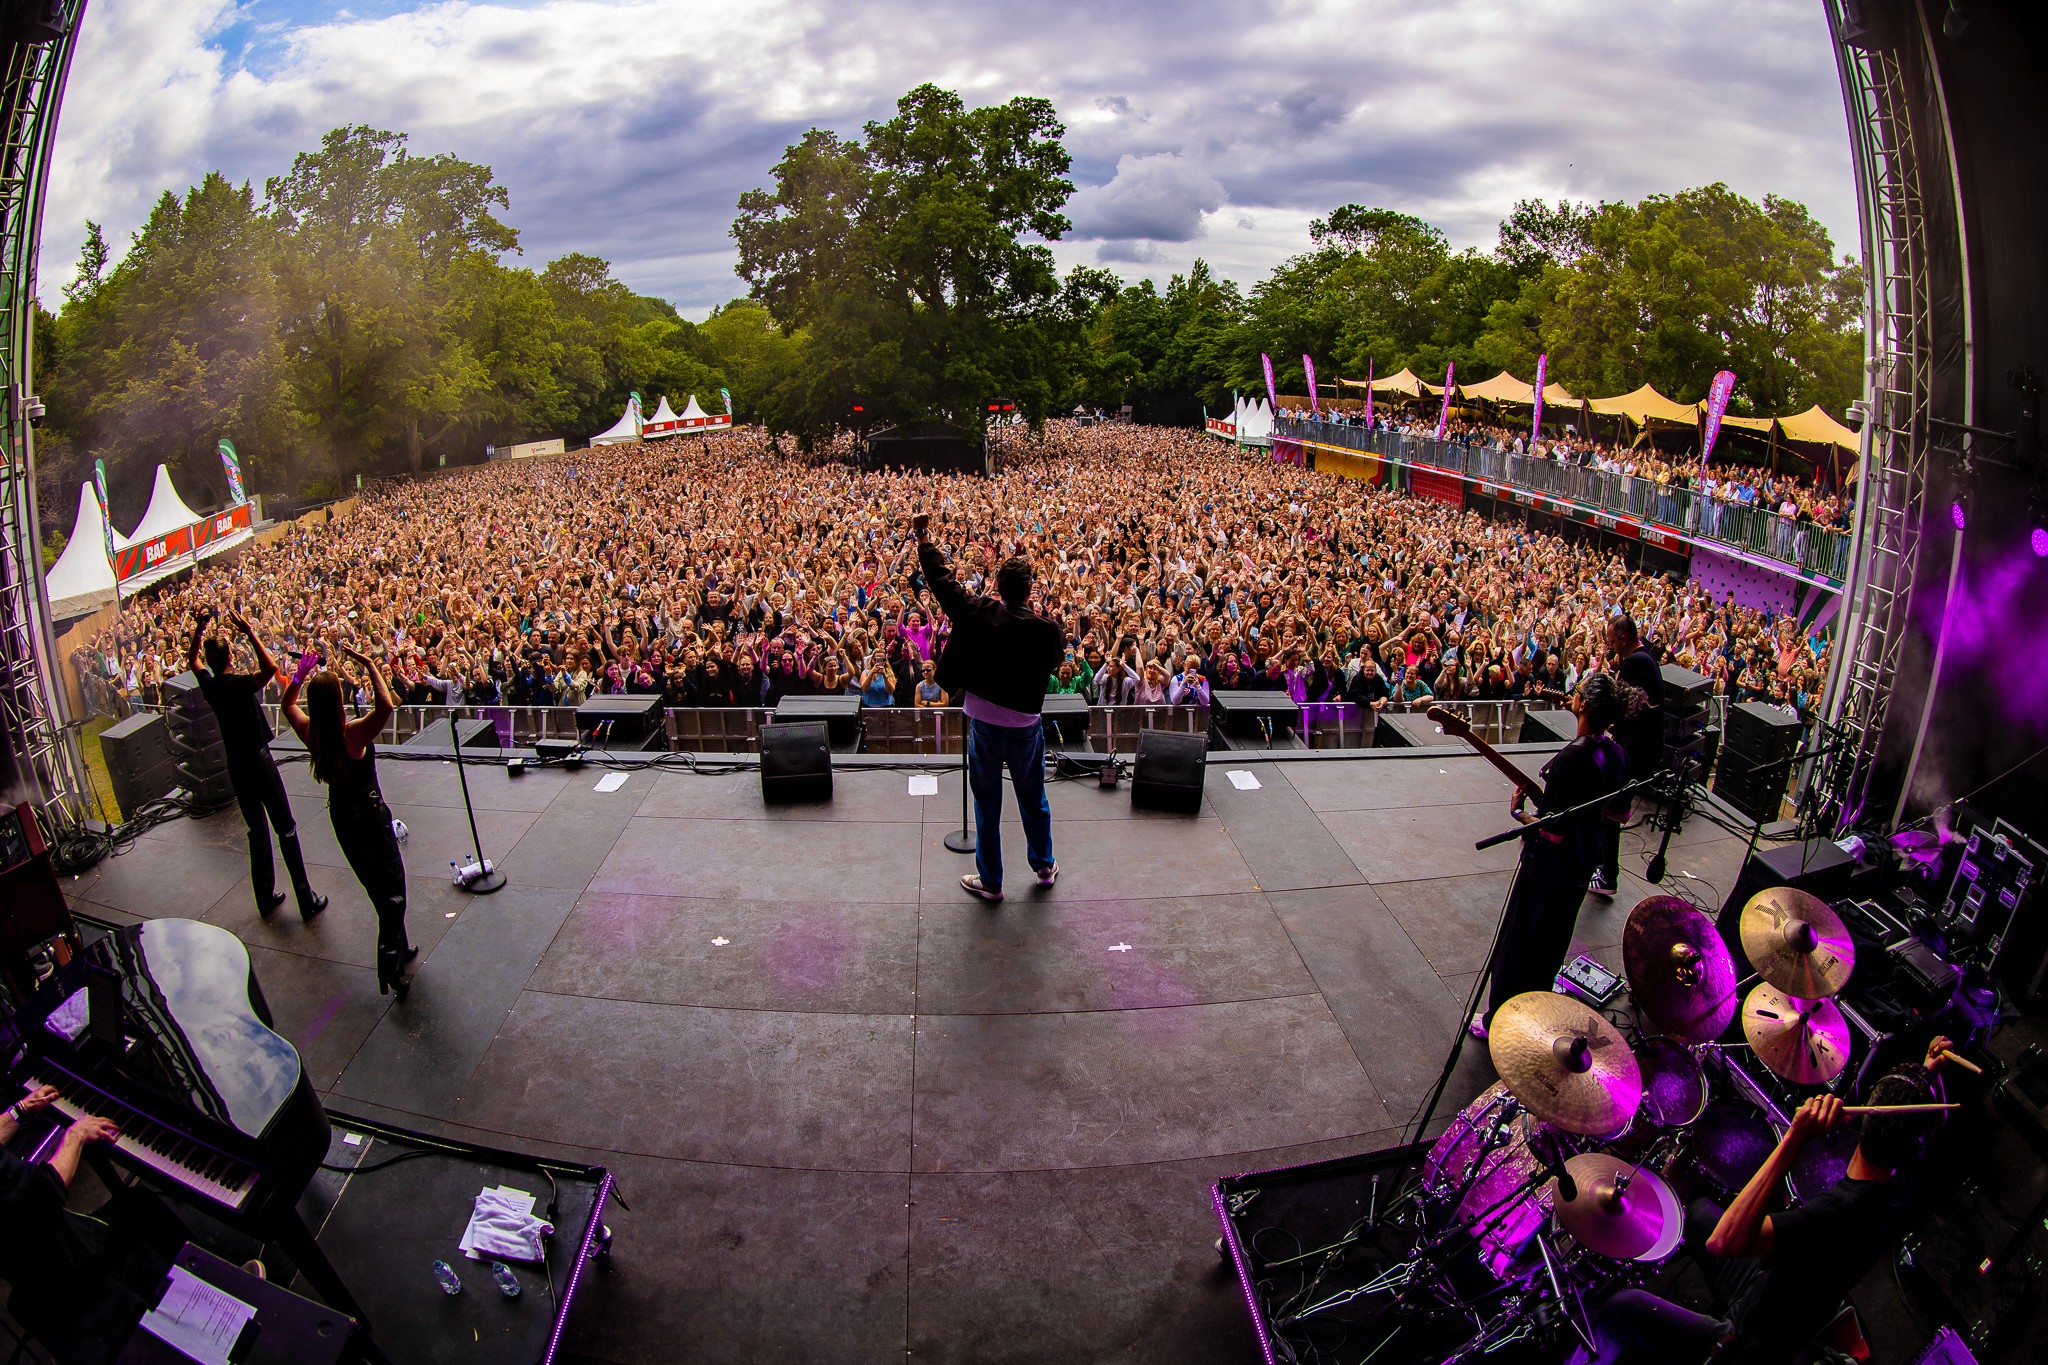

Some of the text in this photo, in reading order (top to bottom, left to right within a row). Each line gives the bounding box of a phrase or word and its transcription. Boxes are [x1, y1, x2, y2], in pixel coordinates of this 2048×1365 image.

[216, 516, 233, 534] BAR
[145, 541, 168, 563] BAR
[1755, 899, 1788, 931] K
[1816, 1038, 1830, 1055] K
